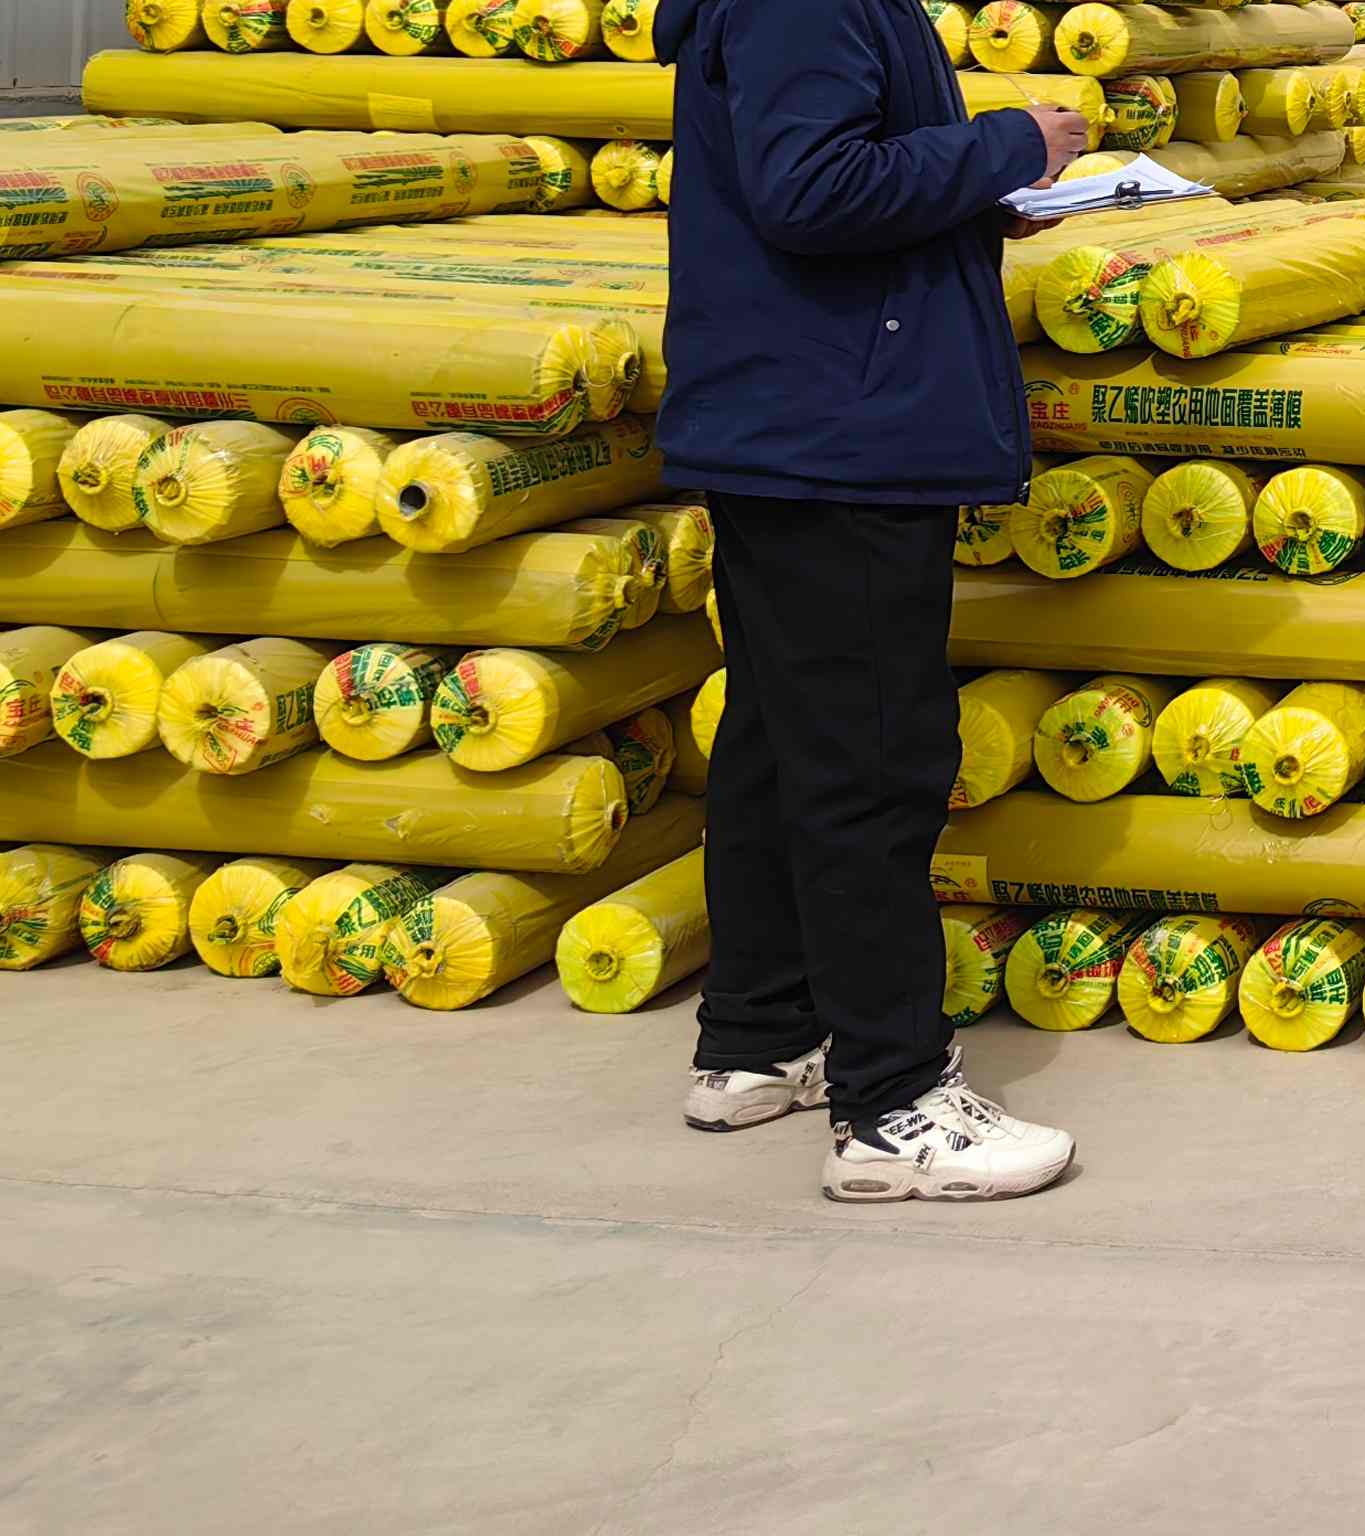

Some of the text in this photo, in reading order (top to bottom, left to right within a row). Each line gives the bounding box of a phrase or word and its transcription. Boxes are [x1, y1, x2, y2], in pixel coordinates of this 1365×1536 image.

[1031, 400, 1071, 420] 宝庄
[1092, 383, 1304, 430] 聚乙烯吹塑农用地面覆盖薄膜
